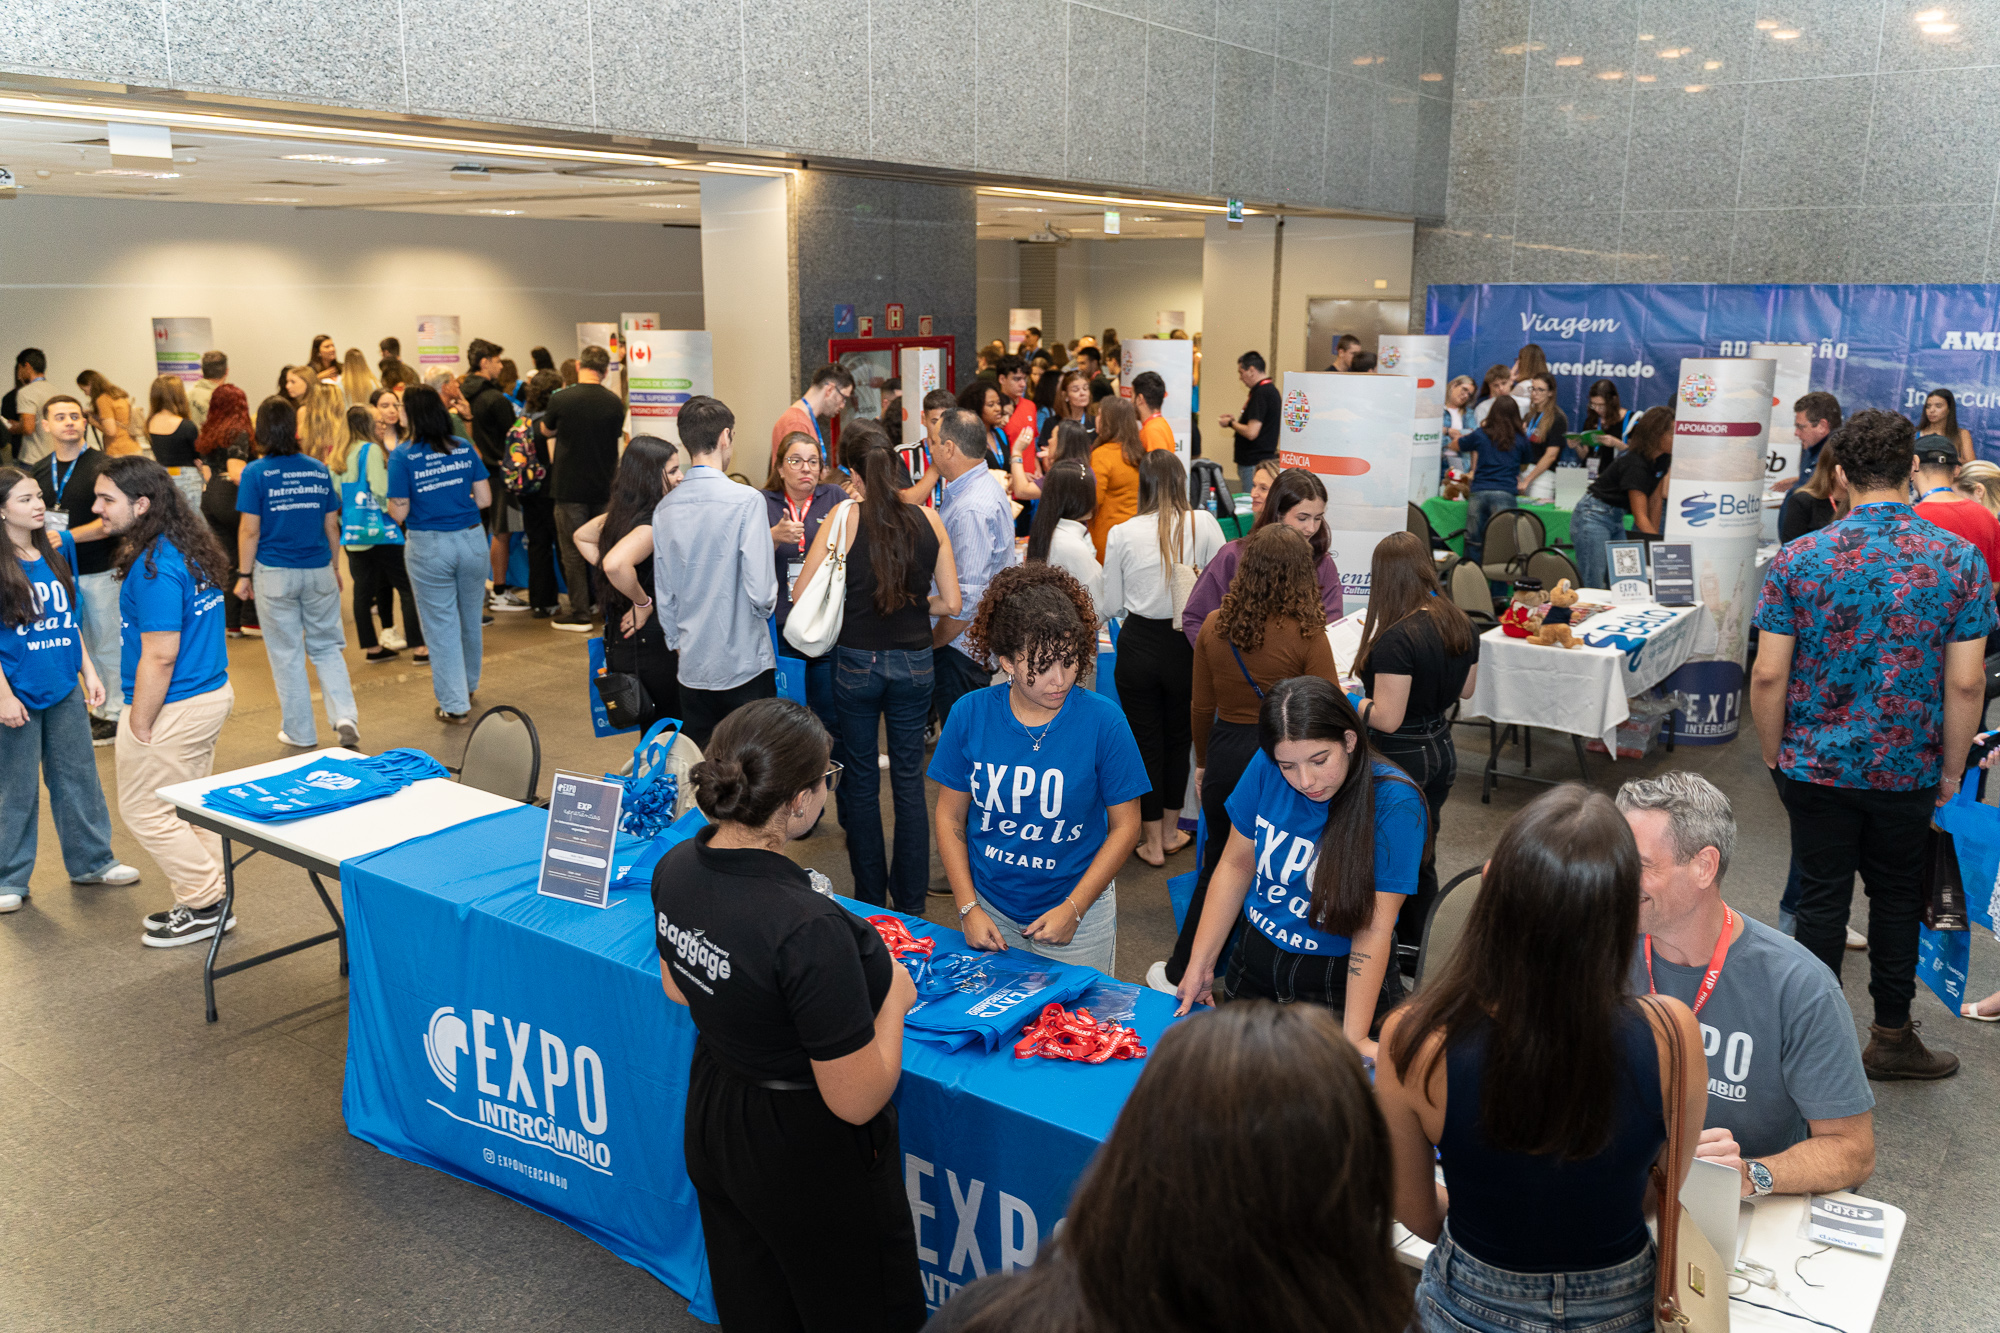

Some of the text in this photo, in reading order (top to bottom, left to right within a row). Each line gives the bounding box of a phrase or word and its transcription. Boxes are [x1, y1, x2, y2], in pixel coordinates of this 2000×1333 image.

[1520, 311, 1621, 339] Viagem
[1677, 423, 1728, 434] APOIADOR
[414, 460, 473, 480] Intercâmbio?
[1281, 453, 1311, 468] AGÊNCIA
[1620, 582, 1638, 593] EXPO
[563, 783, 577, 794] EXPO
[970, 762, 1064, 819] EXPO
[577, 802, 593, 811] EXP
[984, 844, 1056, 870] WIZARD
[1255, 814, 1321, 893] XP
[1249, 906, 1319, 951] WIZARD
[658, 911, 731, 981] Baggage
[1707, 970, 1719, 990] VIP
[1699, 1022, 1753, 1083] PO
[472, 1008, 608, 1136] EXPO
[478, 1098, 611, 1168] INTERCÂMBIO
[905, 1152, 1068, 1280] EXP
[1823, 1203, 1859, 1218] EXPO
